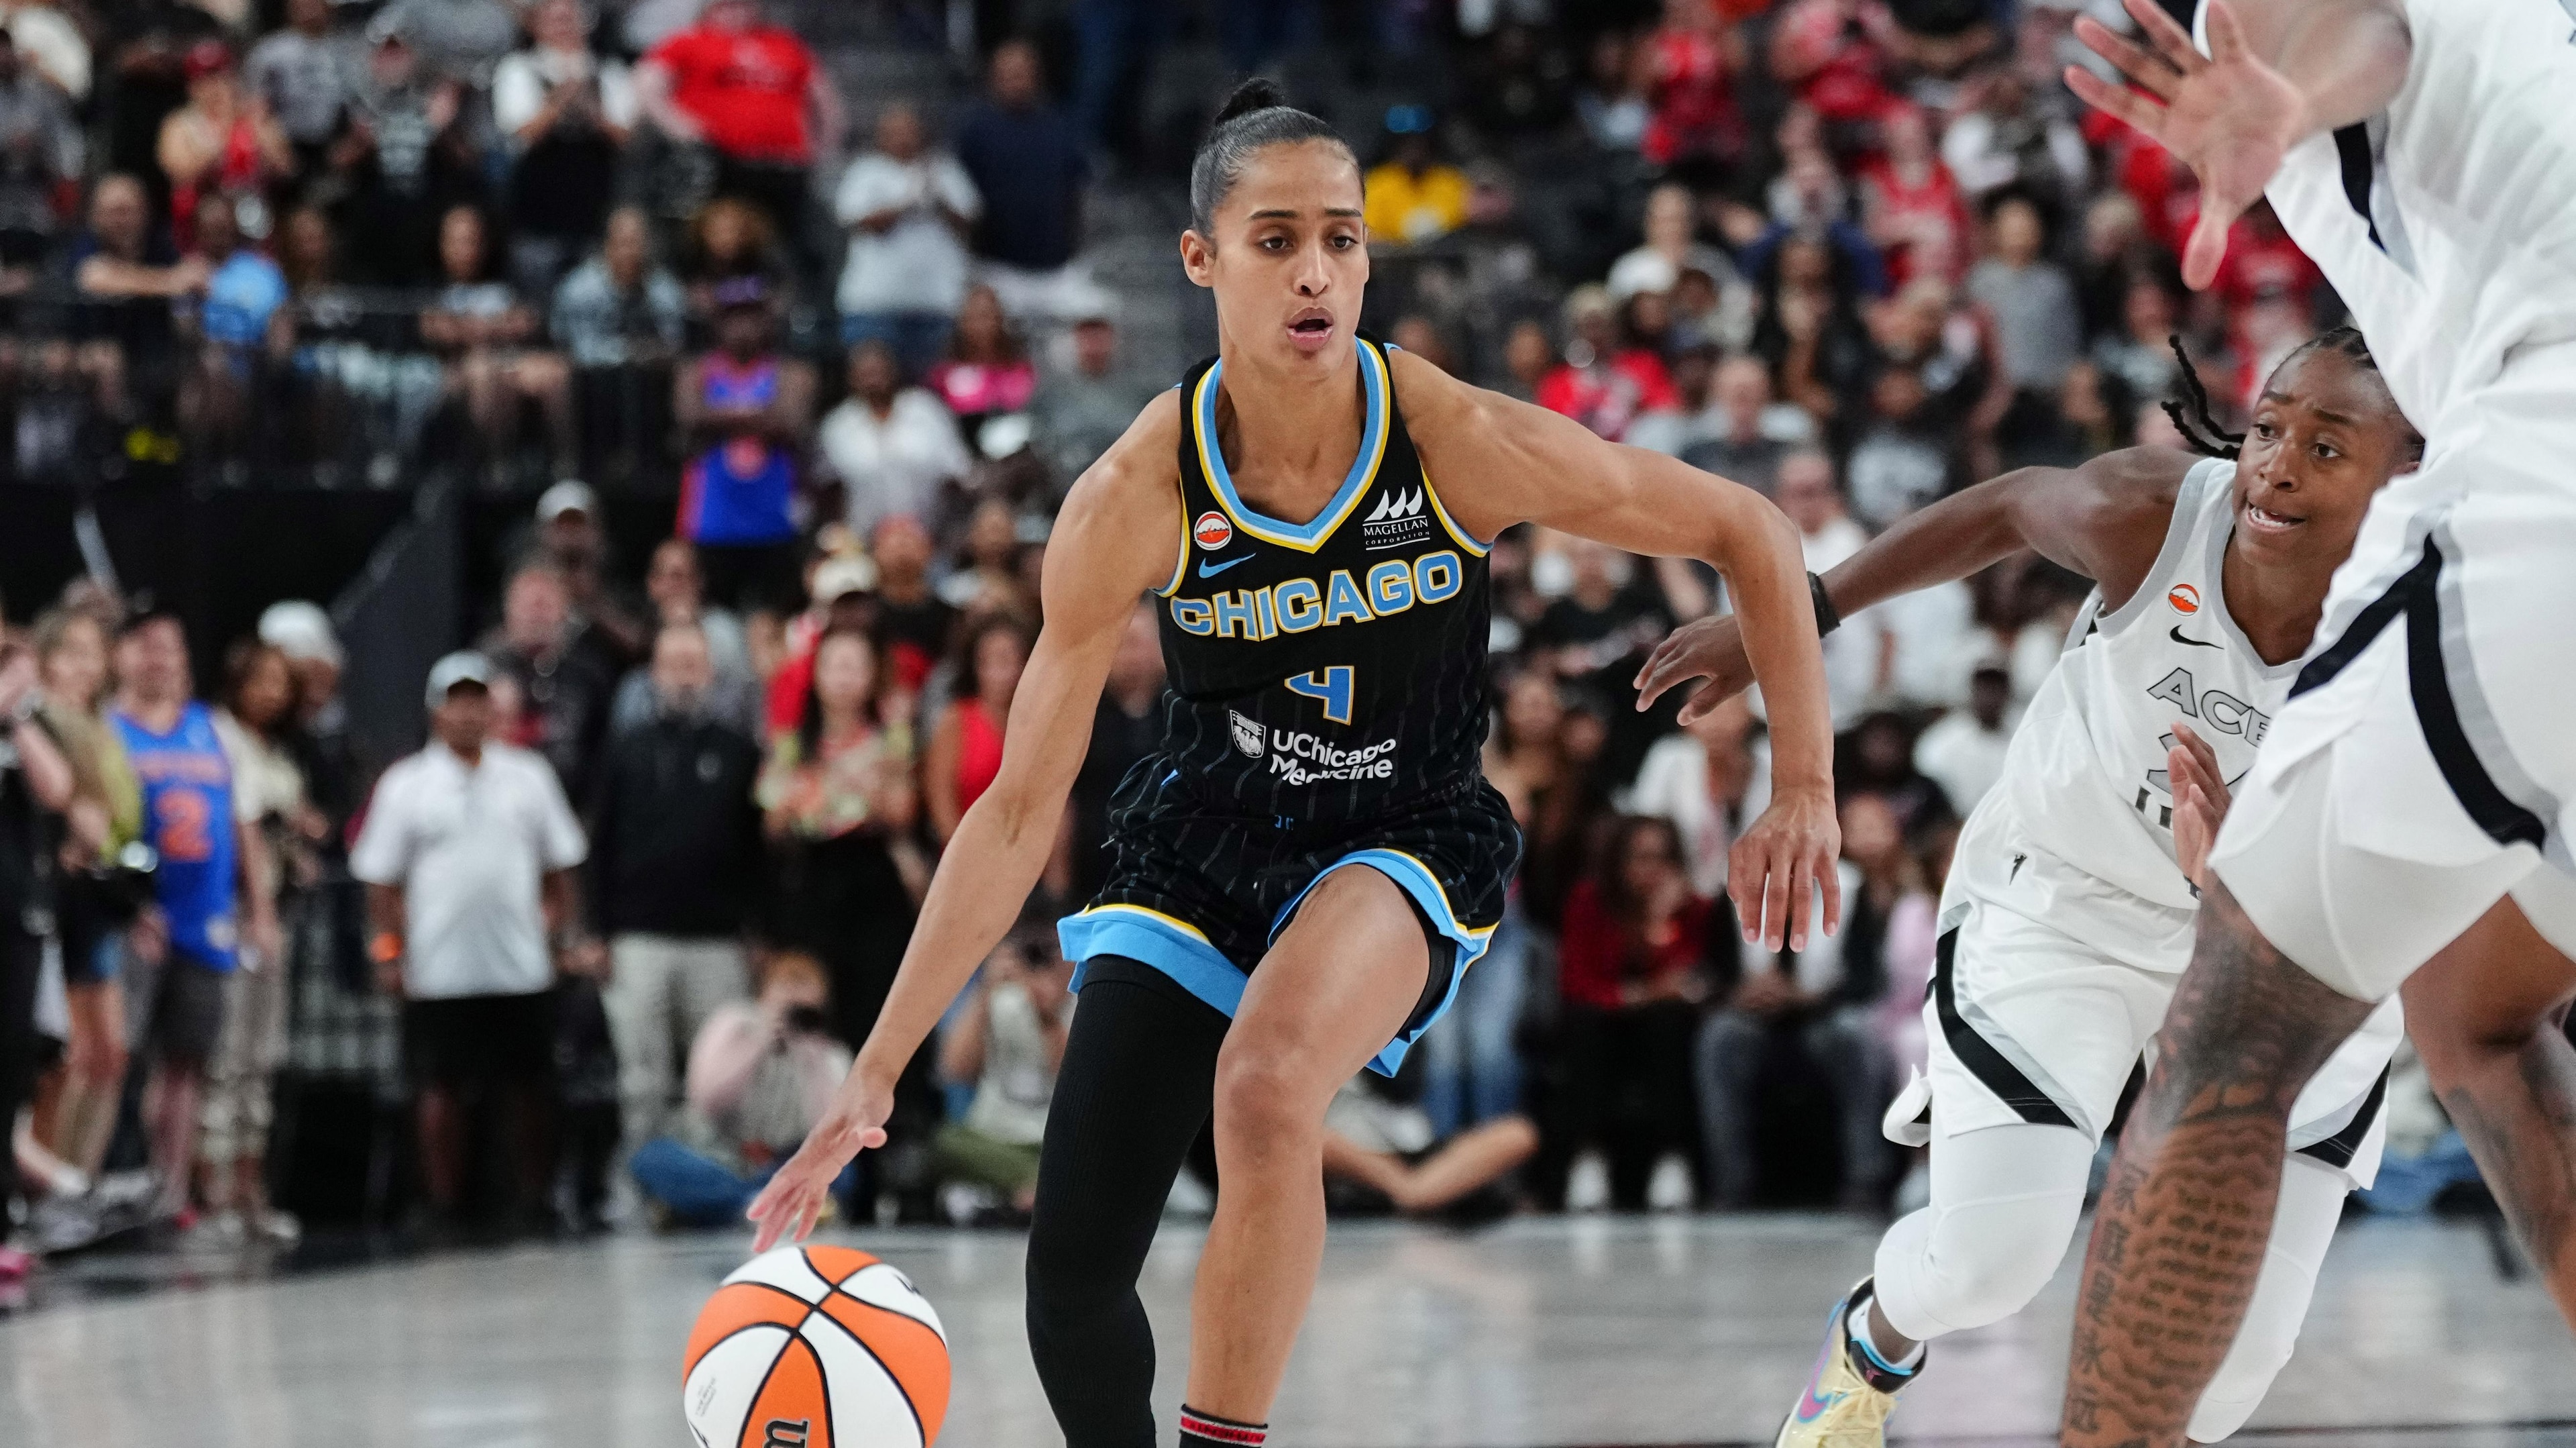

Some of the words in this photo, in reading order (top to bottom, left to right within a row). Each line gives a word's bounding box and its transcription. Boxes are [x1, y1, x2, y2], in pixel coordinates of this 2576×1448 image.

[1364, 519, 1428, 536] MAGELLAN
[1365, 531, 1430, 546] CORPORATION
[1170, 550, 1463, 641] CHICAGO
[1284, 665, 1355, 725] 4
[2147, 667, 2271, 747] ACE
[1273, 729, 1397, 768] UChicago
[158, 786, 215, 862] 2
